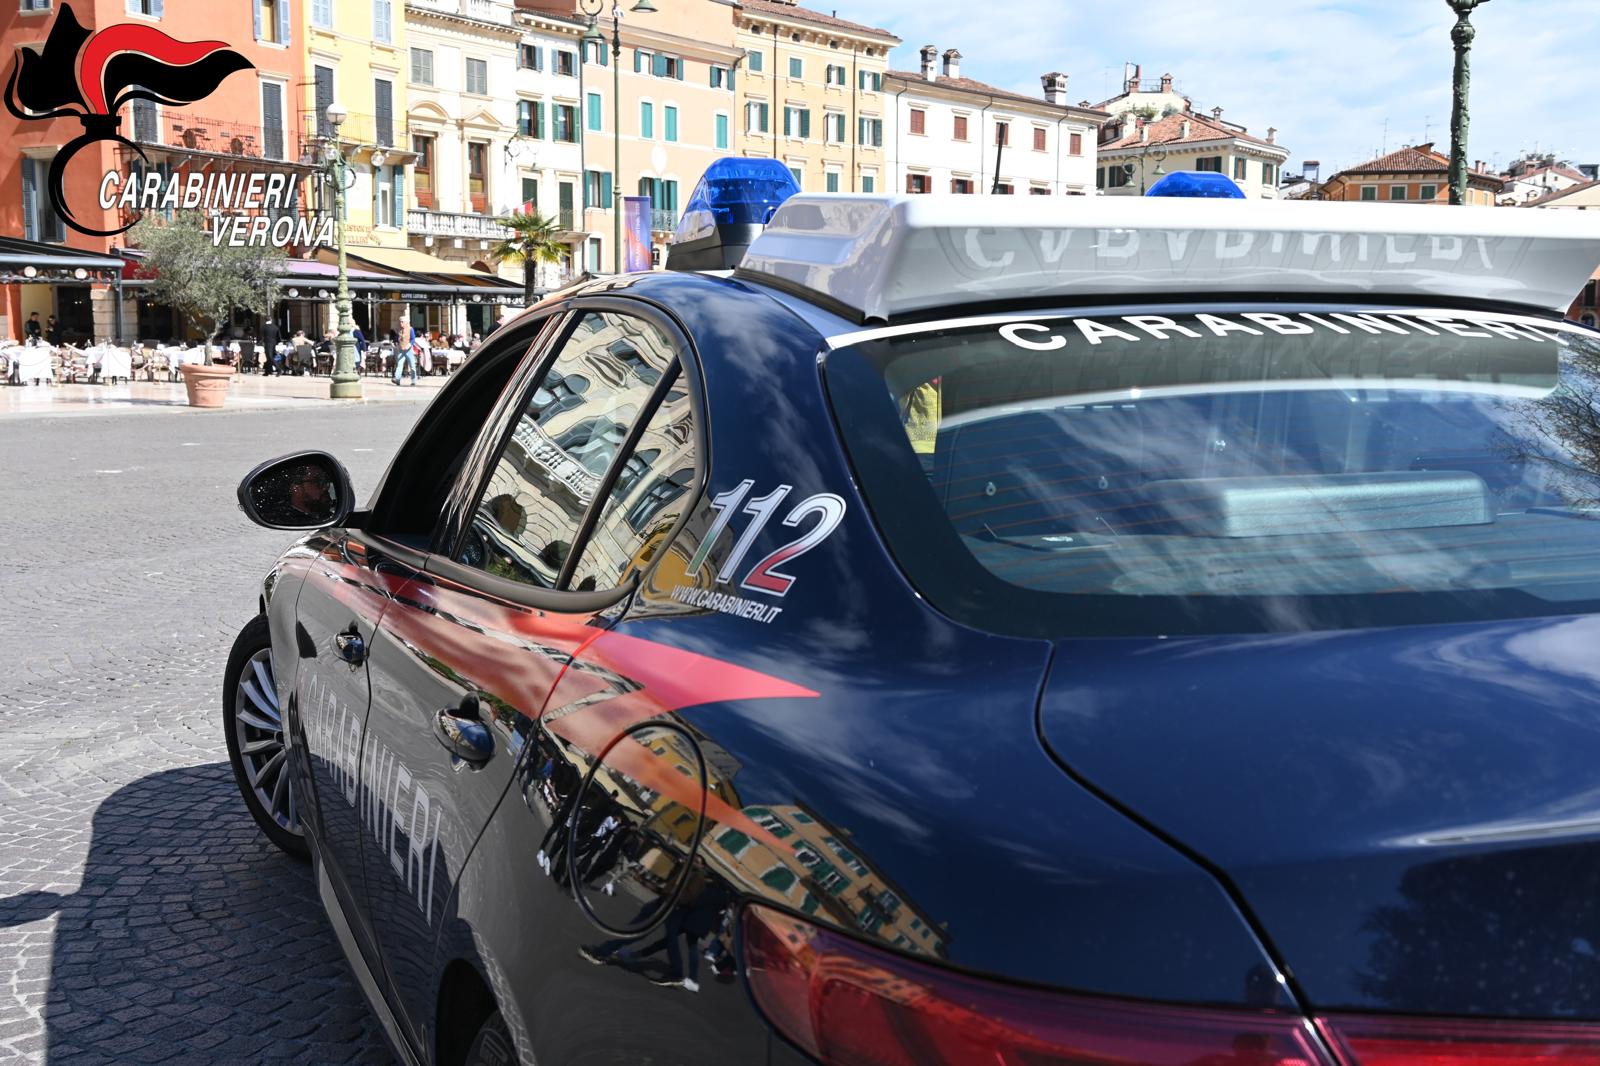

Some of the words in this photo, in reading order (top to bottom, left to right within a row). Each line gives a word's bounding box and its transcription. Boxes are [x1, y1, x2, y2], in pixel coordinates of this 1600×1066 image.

[999, 311, 1570, 351] CARABINIERI
[685, 478, 847, 597] 112
[671, 584, 782, 624] WWW.CARABINIERI.IT
[306, 671, 443, 929] CARABINIERI
